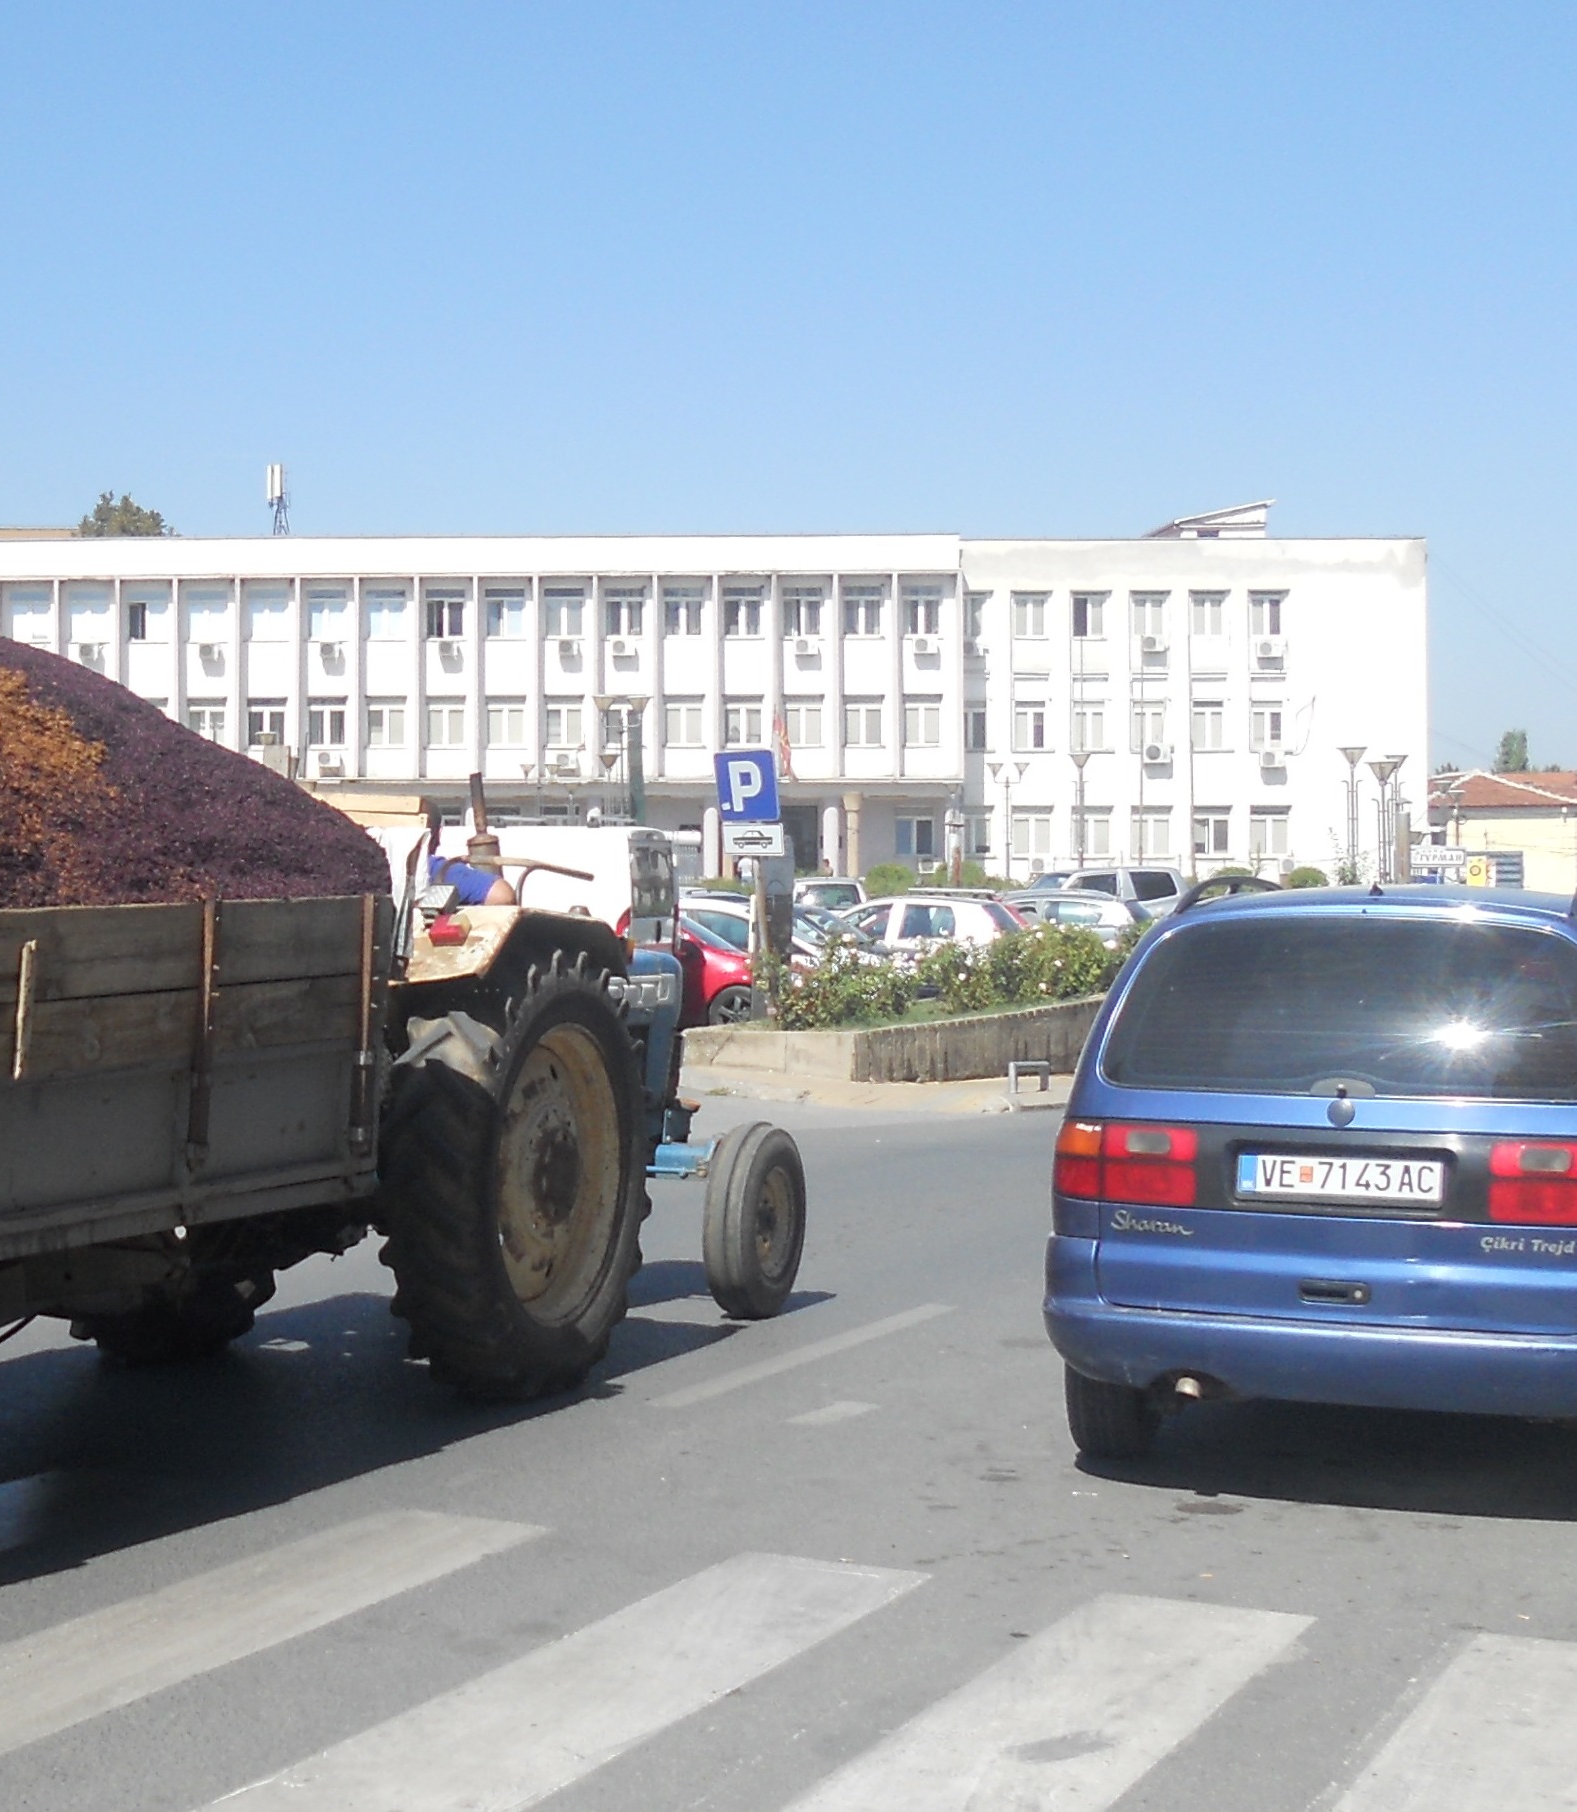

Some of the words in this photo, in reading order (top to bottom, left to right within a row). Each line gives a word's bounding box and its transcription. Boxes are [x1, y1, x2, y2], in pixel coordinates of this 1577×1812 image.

[728, 761, 761, 811] P
[1262, 1160, 1296, 1188] VE
[1318, 1161, 1391, 1191] 7143
[1398, 1165, 1434, 1194] AC
[1110, 1209, 1194, 1236] Sharan
[1480, 1237, 1525, 1253] Çikri
